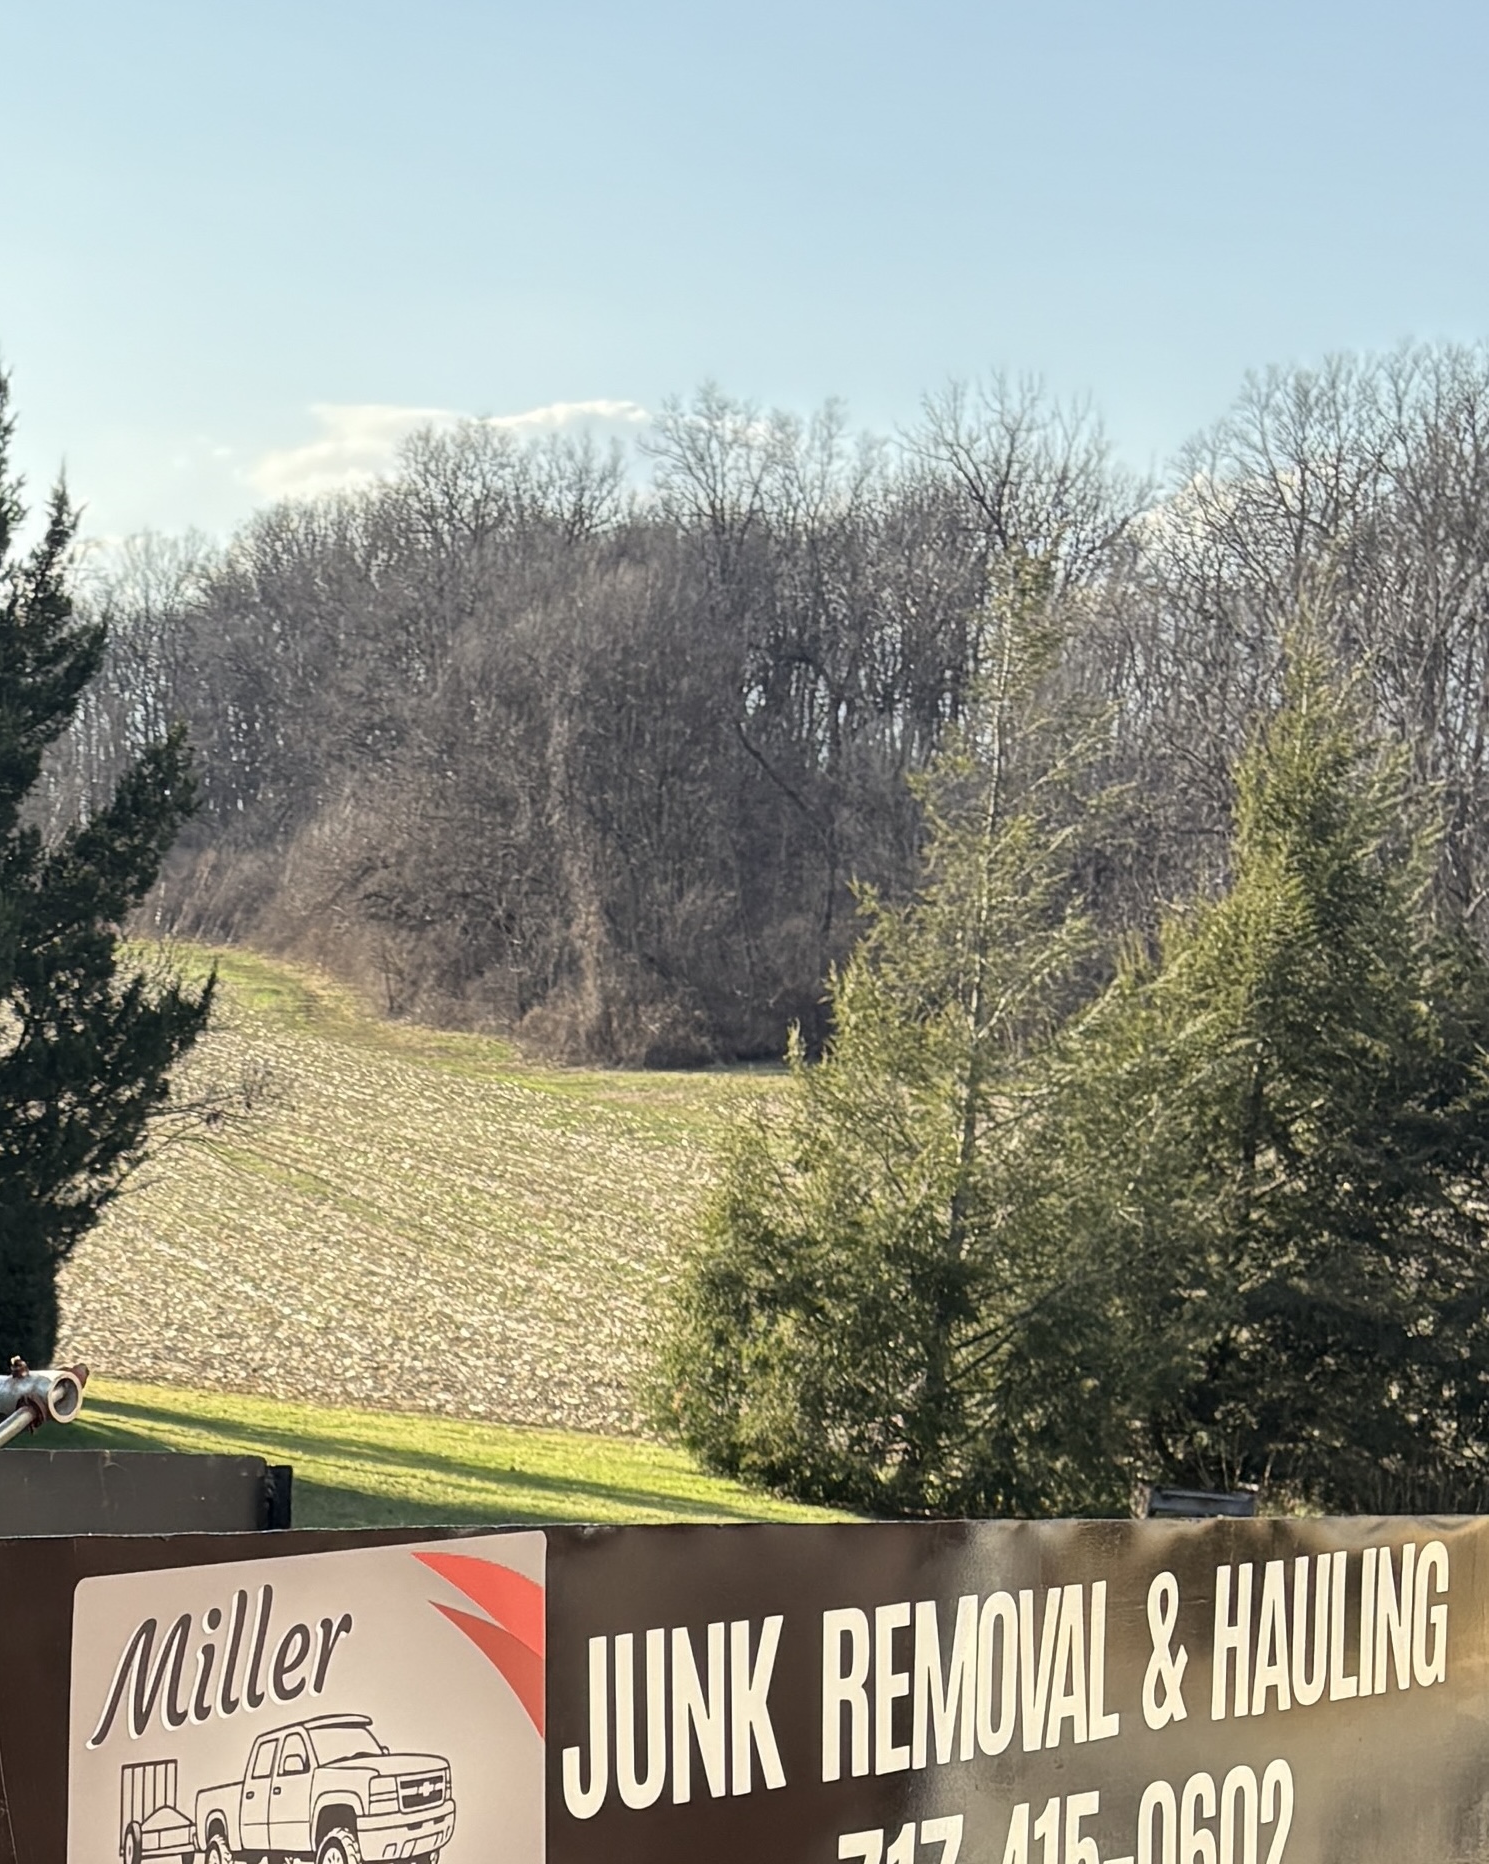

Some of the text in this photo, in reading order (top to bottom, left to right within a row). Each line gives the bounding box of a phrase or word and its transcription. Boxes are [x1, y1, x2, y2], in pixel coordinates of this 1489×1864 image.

[87, 1584, 353, 1748] Miller
[561, 1540, 1450, 1820] JUNK REMOVAL & HAULING
